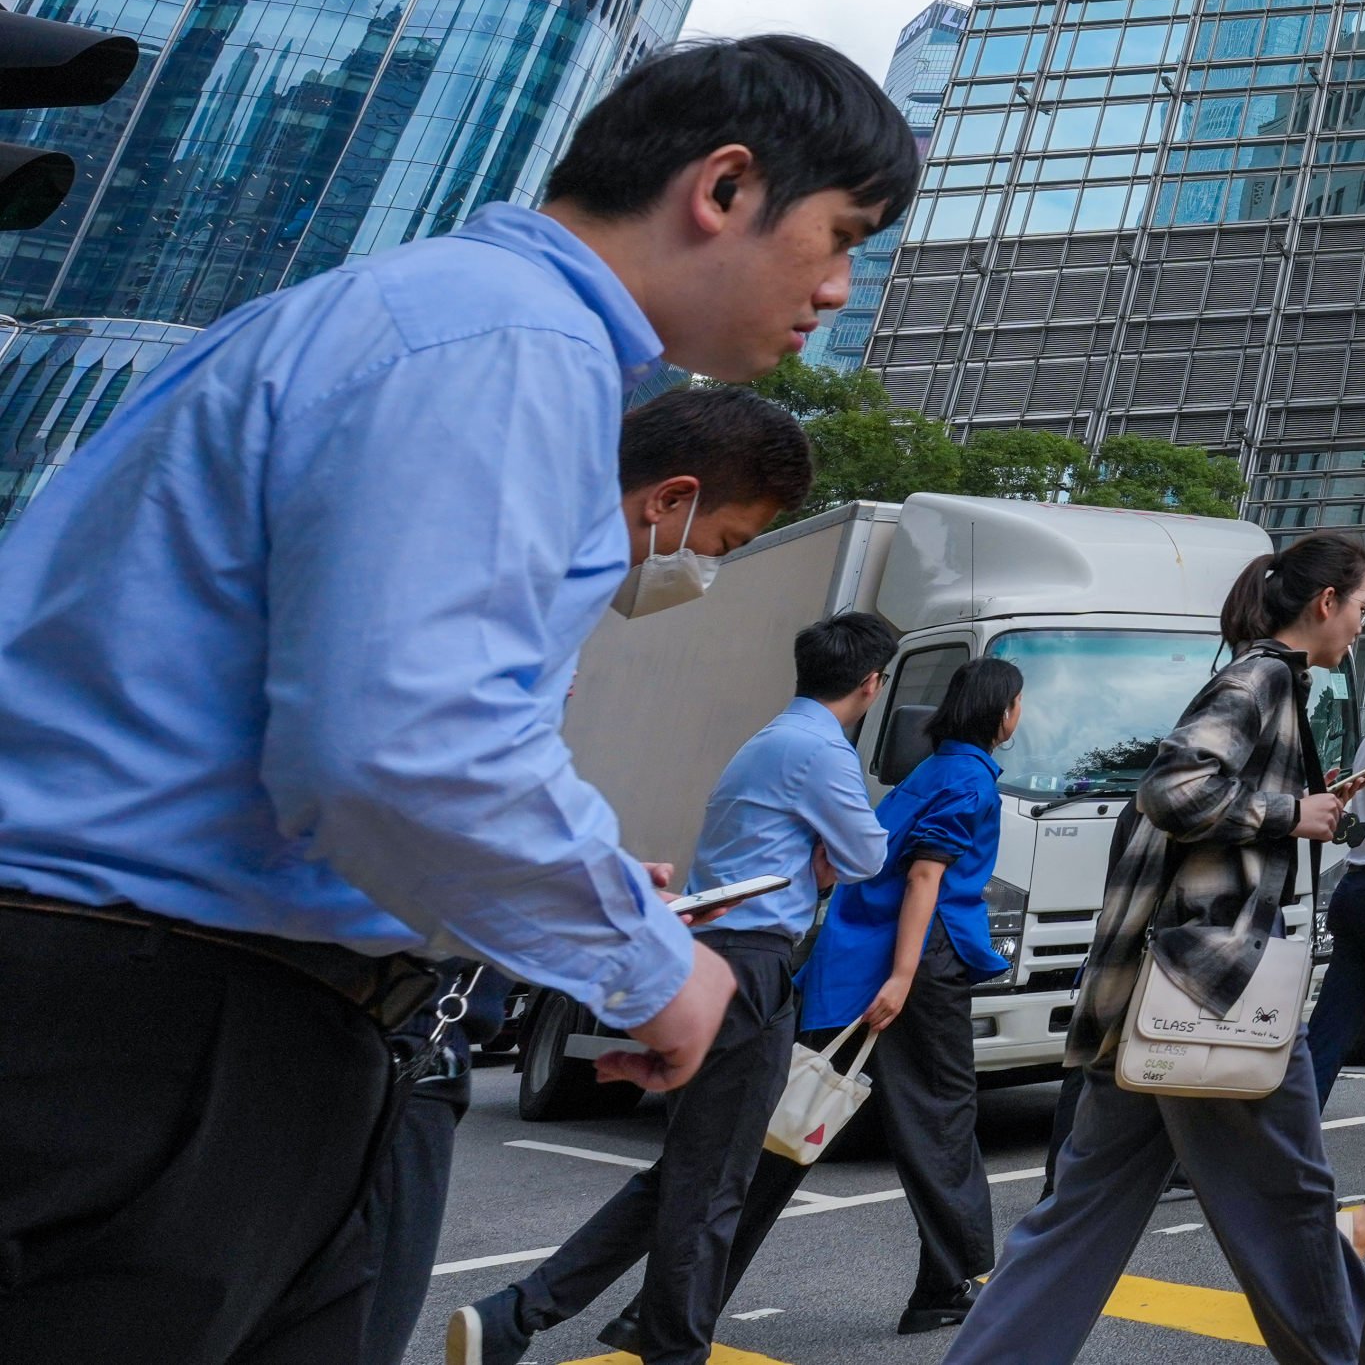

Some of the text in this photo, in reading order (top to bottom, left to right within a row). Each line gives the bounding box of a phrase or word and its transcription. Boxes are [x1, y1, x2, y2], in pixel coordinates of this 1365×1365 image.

[1044, 826, 1079, 837] NQ
[1151, 1017, 1202, 1033] "CLASS"
[1148, 1043, 1189, 1057] CLASS
[1144, 1059, 1175, 1071] CLASS
